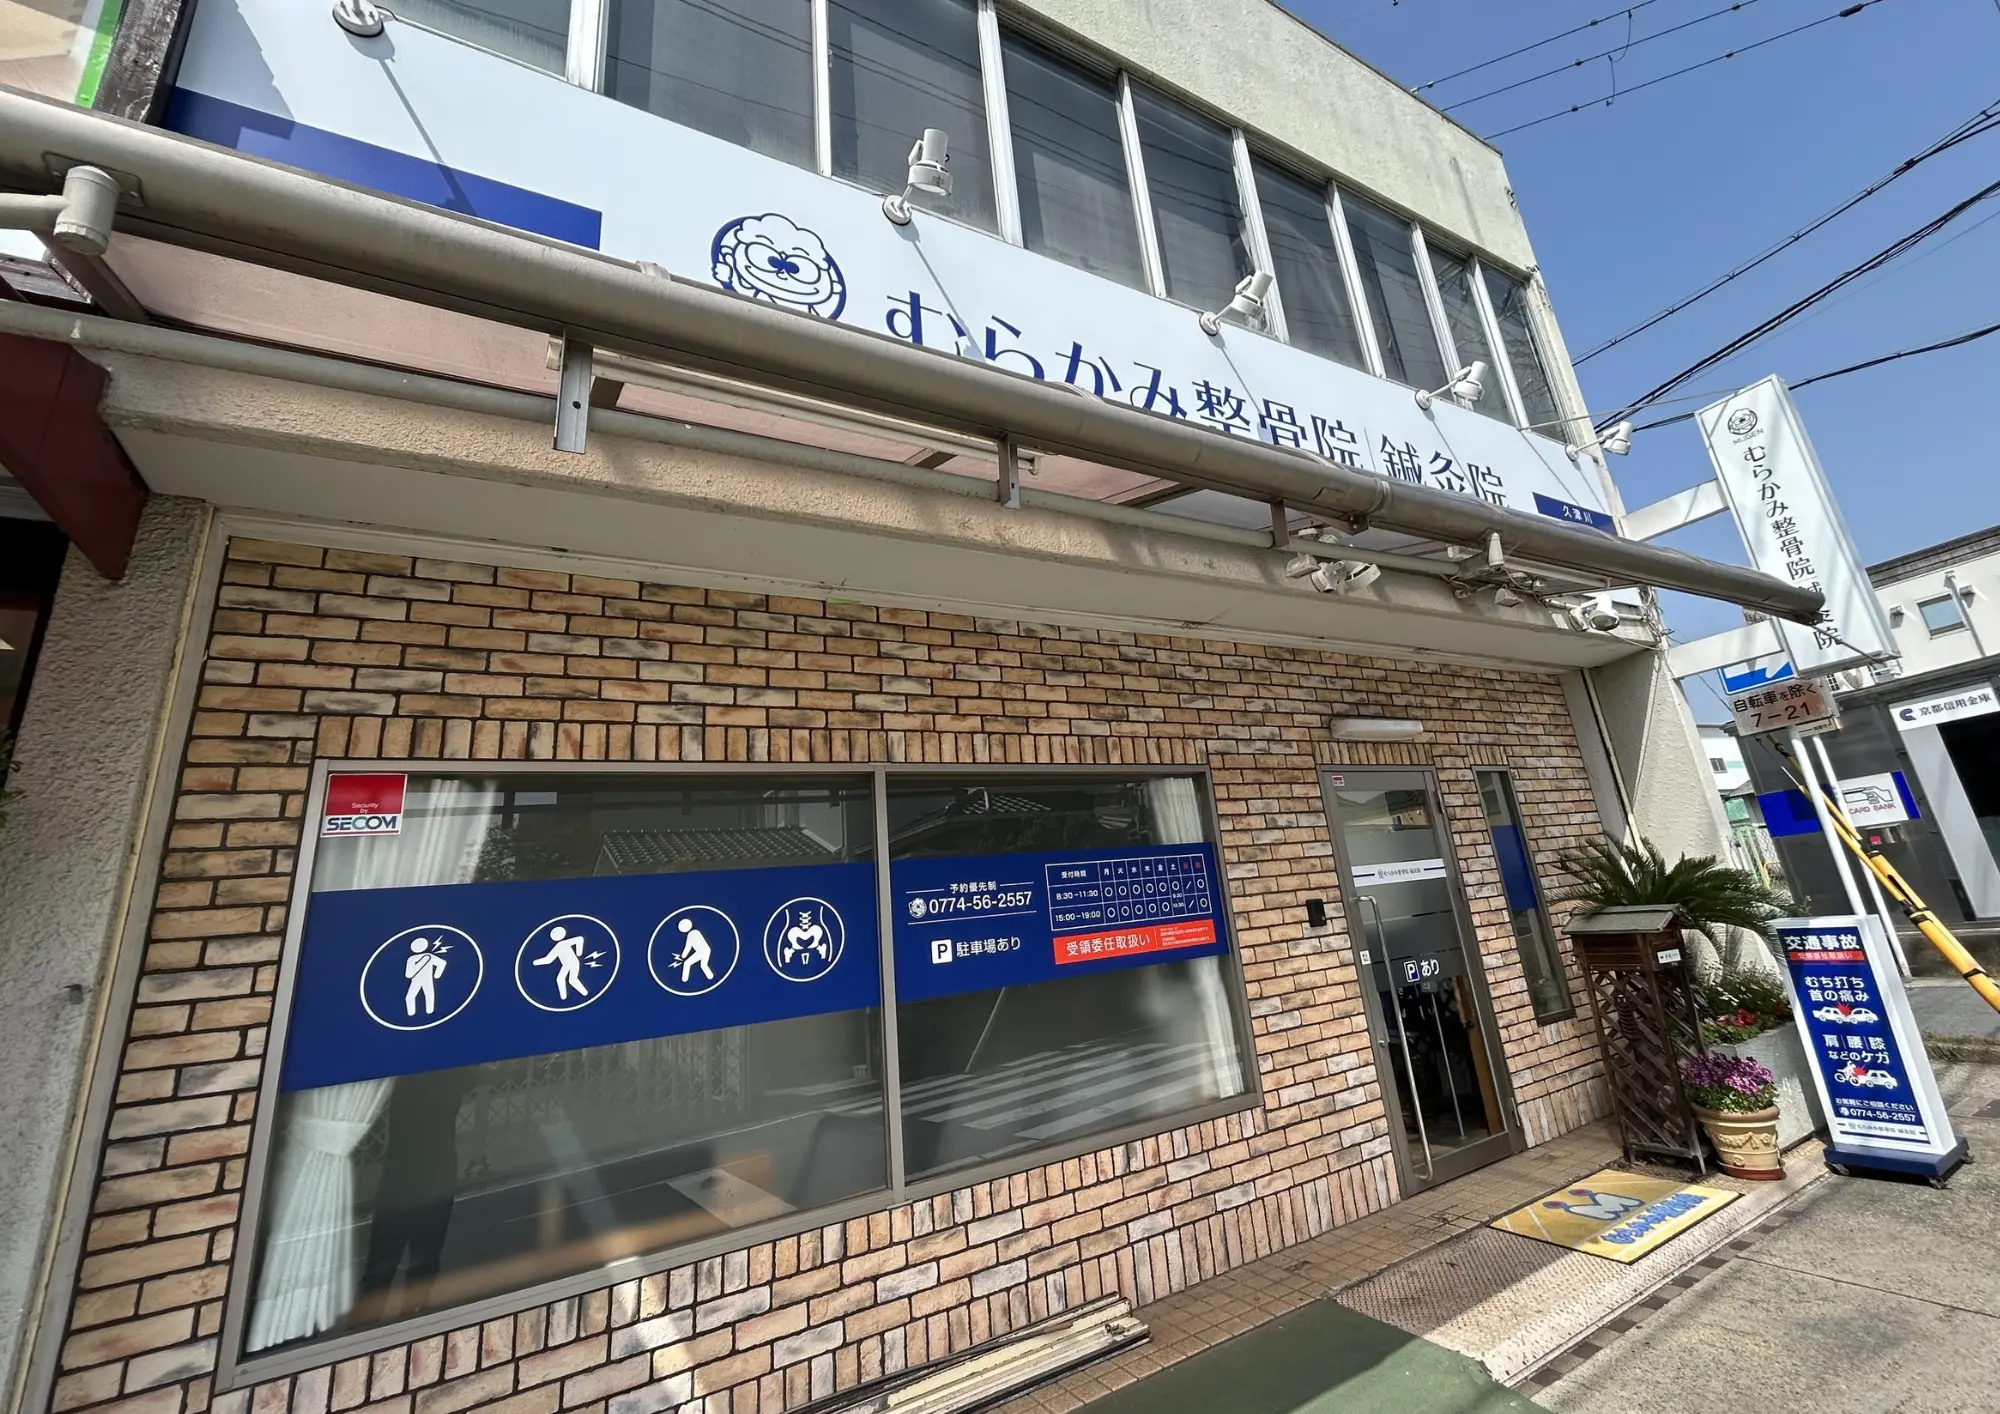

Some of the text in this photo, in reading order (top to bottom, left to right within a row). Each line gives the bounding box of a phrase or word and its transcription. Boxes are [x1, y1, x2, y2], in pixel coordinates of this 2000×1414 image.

[1742, 445, 1816, 581] むらかみ整骨院
[1733, 683, 1817, 713] 自転車を除く
[1918, 693, 1992, 717] 京都信用金庫
[1848, 803, 1897, 815] CARD BANK
[326, 815, 398, 832] SECOM
[1061, 869, 1087, 879] 受付時間
[1103, 868, 1110, 876] 月
[949, 880, 997, 895] 予約優先制
[928, 890, 1033, 914] 0774-56-2557
[936, 936, 1021, 960] P 駐車場あり
[1066, 933, 1151, 957] 受領委任取扱い
[1783, 934, 1861, 951] 交通事故
[1420, 958, 1440, 977] あり
[1804, 976, 1865, 989] むち打ち
[1807, 989, 1870, 1003] 首の痛み
[1822, 1034, 1840, 1048] 肩
[1827, 1050, 1890, 1065] などのケガ
